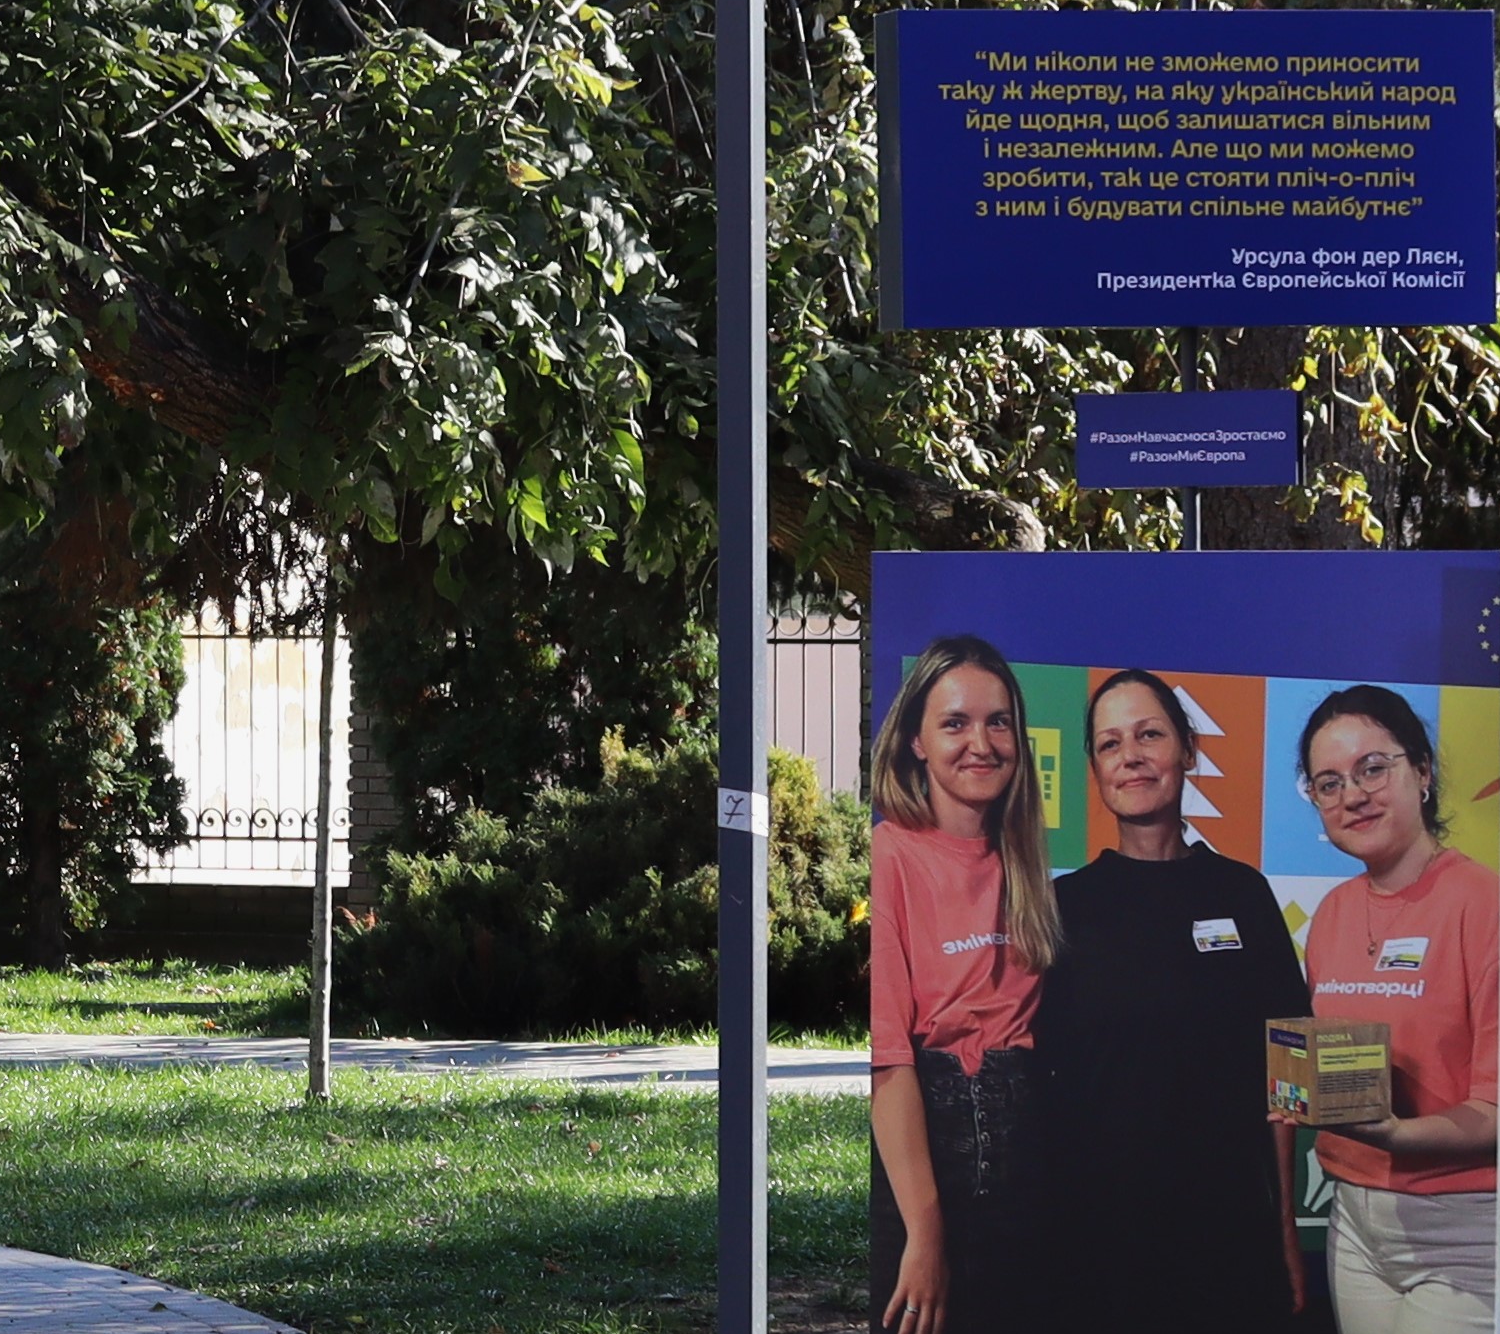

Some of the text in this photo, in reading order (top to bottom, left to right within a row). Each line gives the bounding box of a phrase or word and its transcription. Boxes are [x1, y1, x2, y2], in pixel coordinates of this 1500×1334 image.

[1035, 50, 1118, 72] ніколи
[1125, 55, 1155, 72] не
[1161, 51, 1280, 73] зможемо
[1286, 56, 1420, 77] приносити
[1230, 247, 1465, 269] Урсула фон дер Ляєн,
[1097, 270, 1467, 293] Президентка Європейської Комісії
[1089, 429, 1287, 445] #РазомНавчаємосяЗростаємо
[1129, 449, 1246, 465] #РазомМиЄвропа
[724, 794, 745, 825] 7
